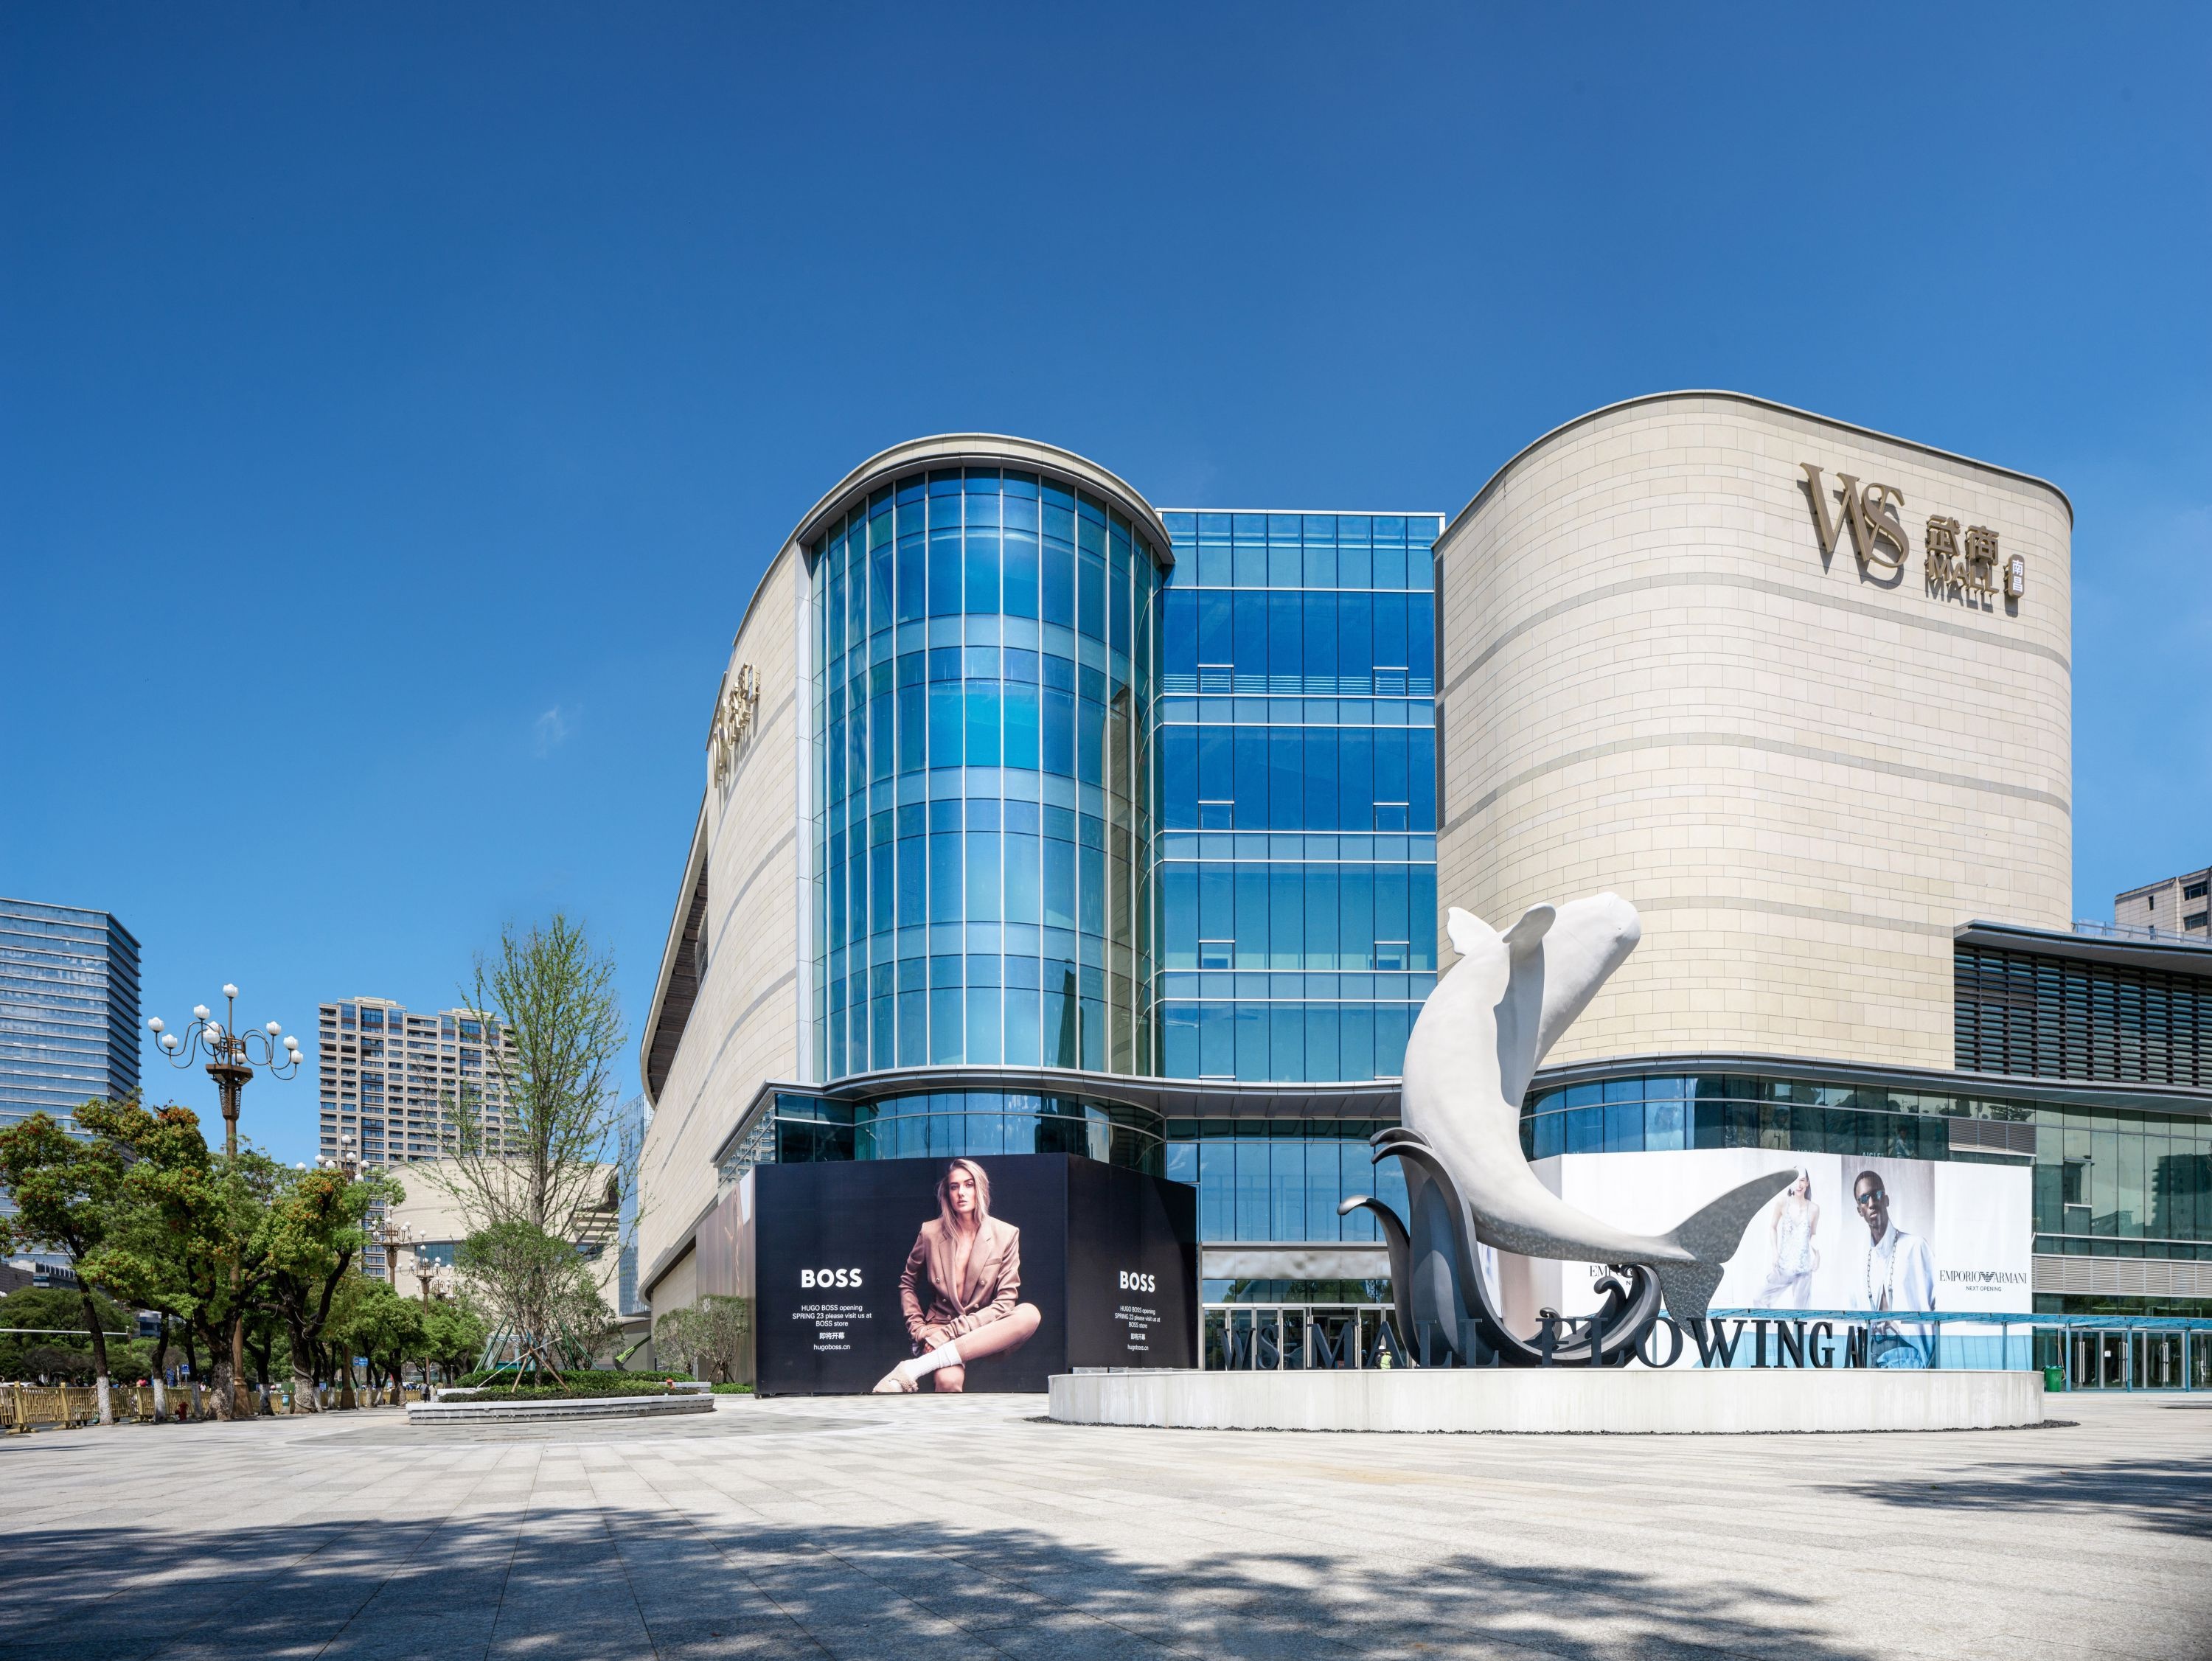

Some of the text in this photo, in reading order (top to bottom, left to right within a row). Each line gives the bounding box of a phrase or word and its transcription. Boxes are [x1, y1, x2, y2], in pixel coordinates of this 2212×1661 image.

[1800, 462, 1910, 568] WS
[1927, 514, 2000, 565] 武商
[1928, 554, 2000, 593] MALL
[2012, 560, 2024, 592] 南昌
[801, 1268, 863, 1288] BOSS
[1119, 1271, 1155, 1292] BOSS
[1940, 1270, 2027, 1284] EMPORIO ARMANI
[813, 1343, 851, 1351] hugoboss.cn
[1217, 1324, 1280, 1371] WS
[1307, 1318, 1499, 1370] MALL
[1536, 1315, 1836, 1369] FLOWING
